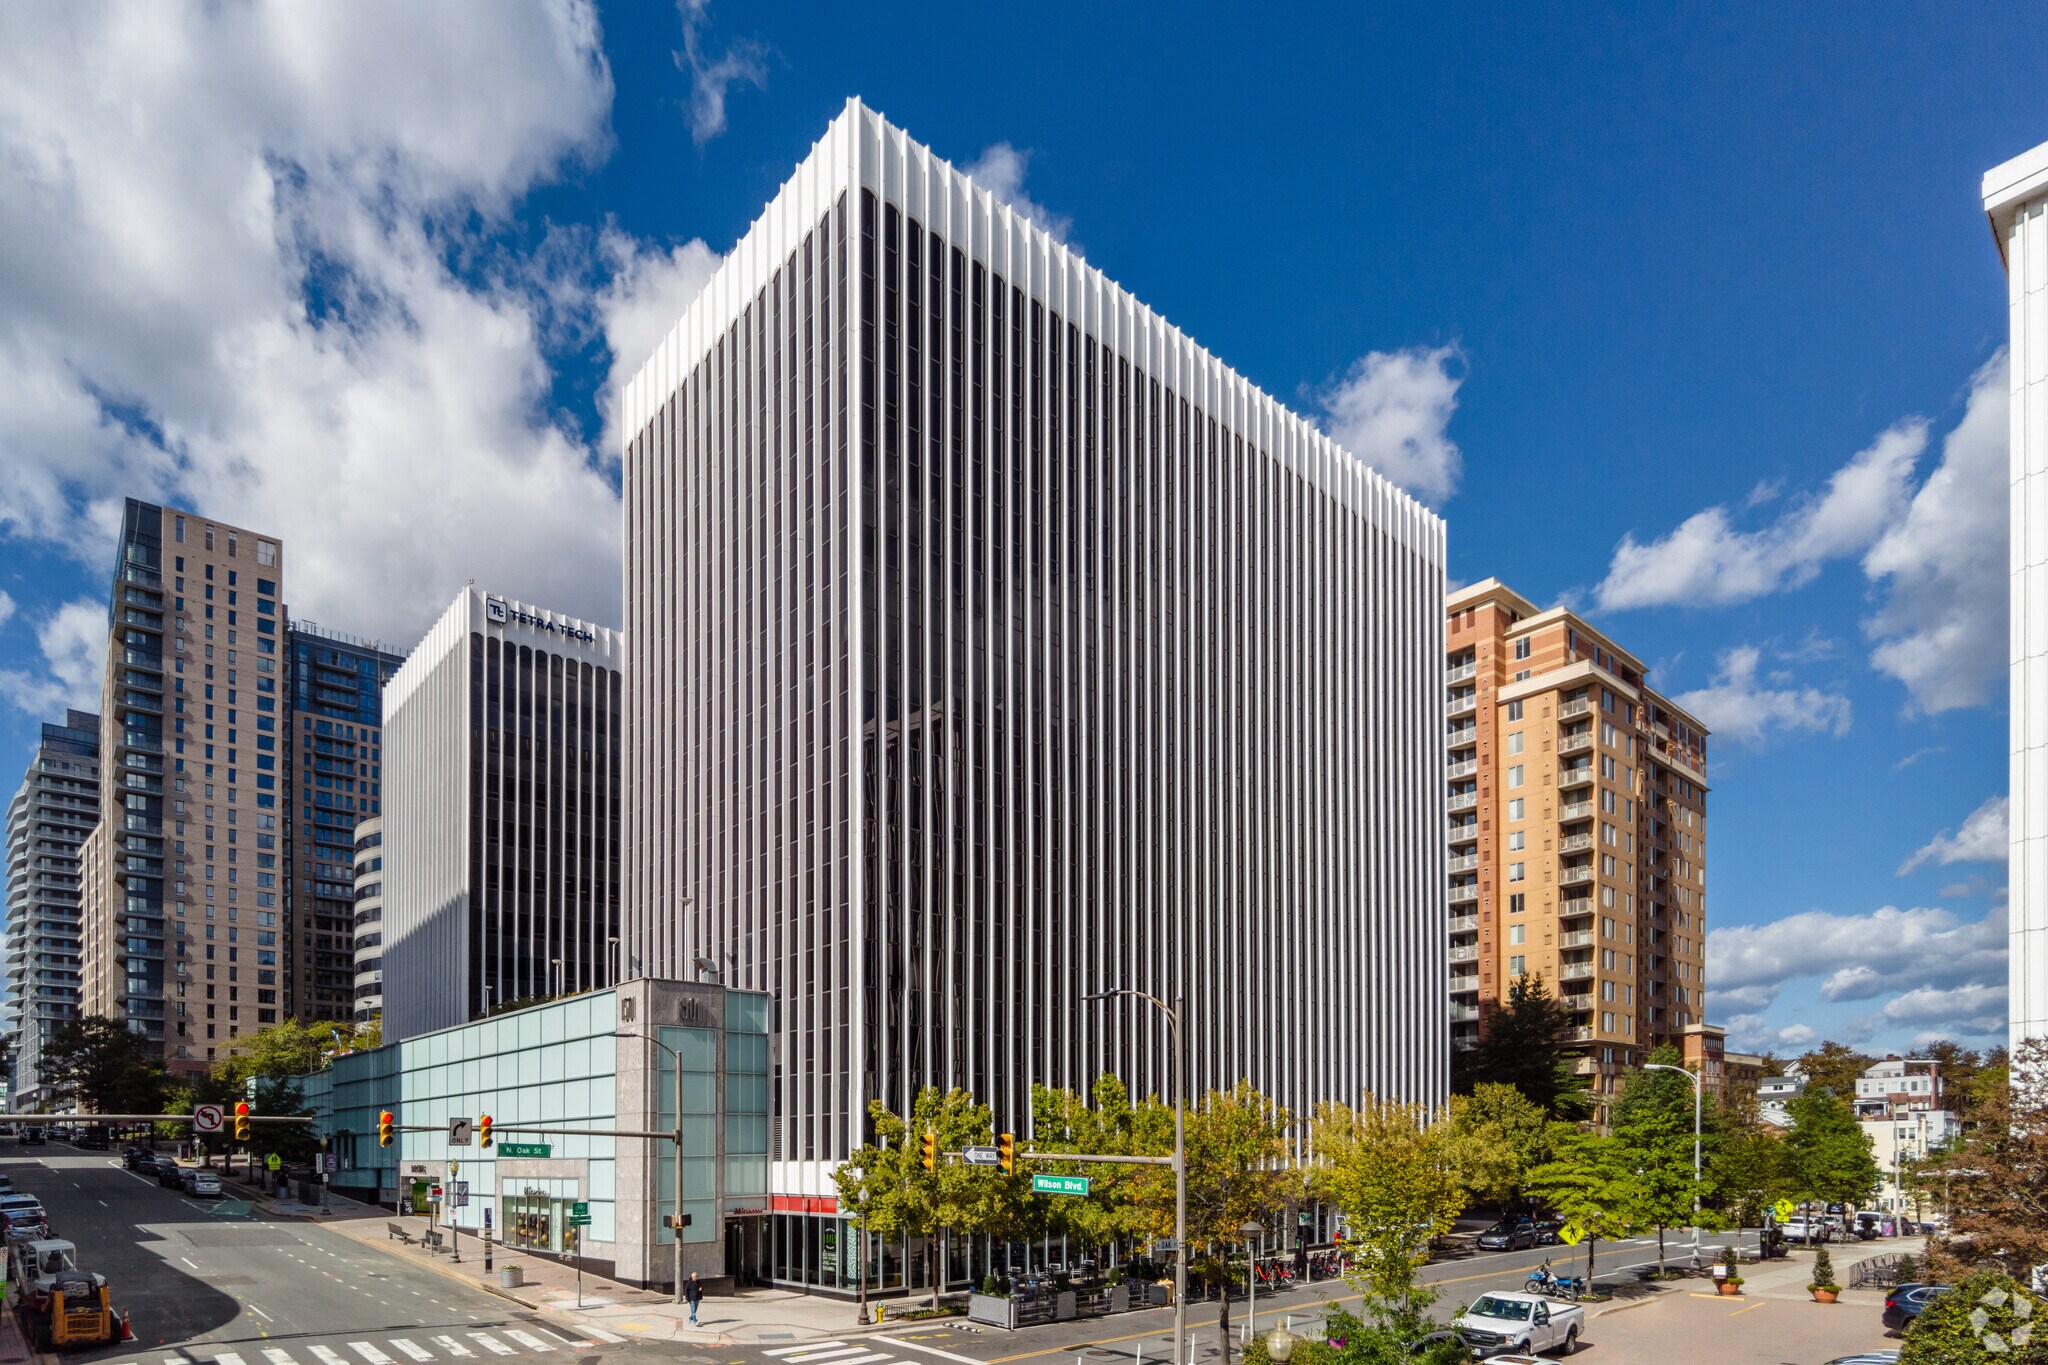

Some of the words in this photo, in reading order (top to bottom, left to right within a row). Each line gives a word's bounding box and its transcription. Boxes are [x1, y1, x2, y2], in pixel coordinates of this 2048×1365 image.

[510, 610, 555, 632] TETRA
[559, 624, 593, 643] TECH
[533, 1147, 544, 1155] St.
[974, 1151, 984, 1159] ONE
[1037, 1178, 1062, 1189] Wilson
[1064, 1180, 1083, 1191] Blvd.
[1161, 1241, 1171, 1249] OAK
